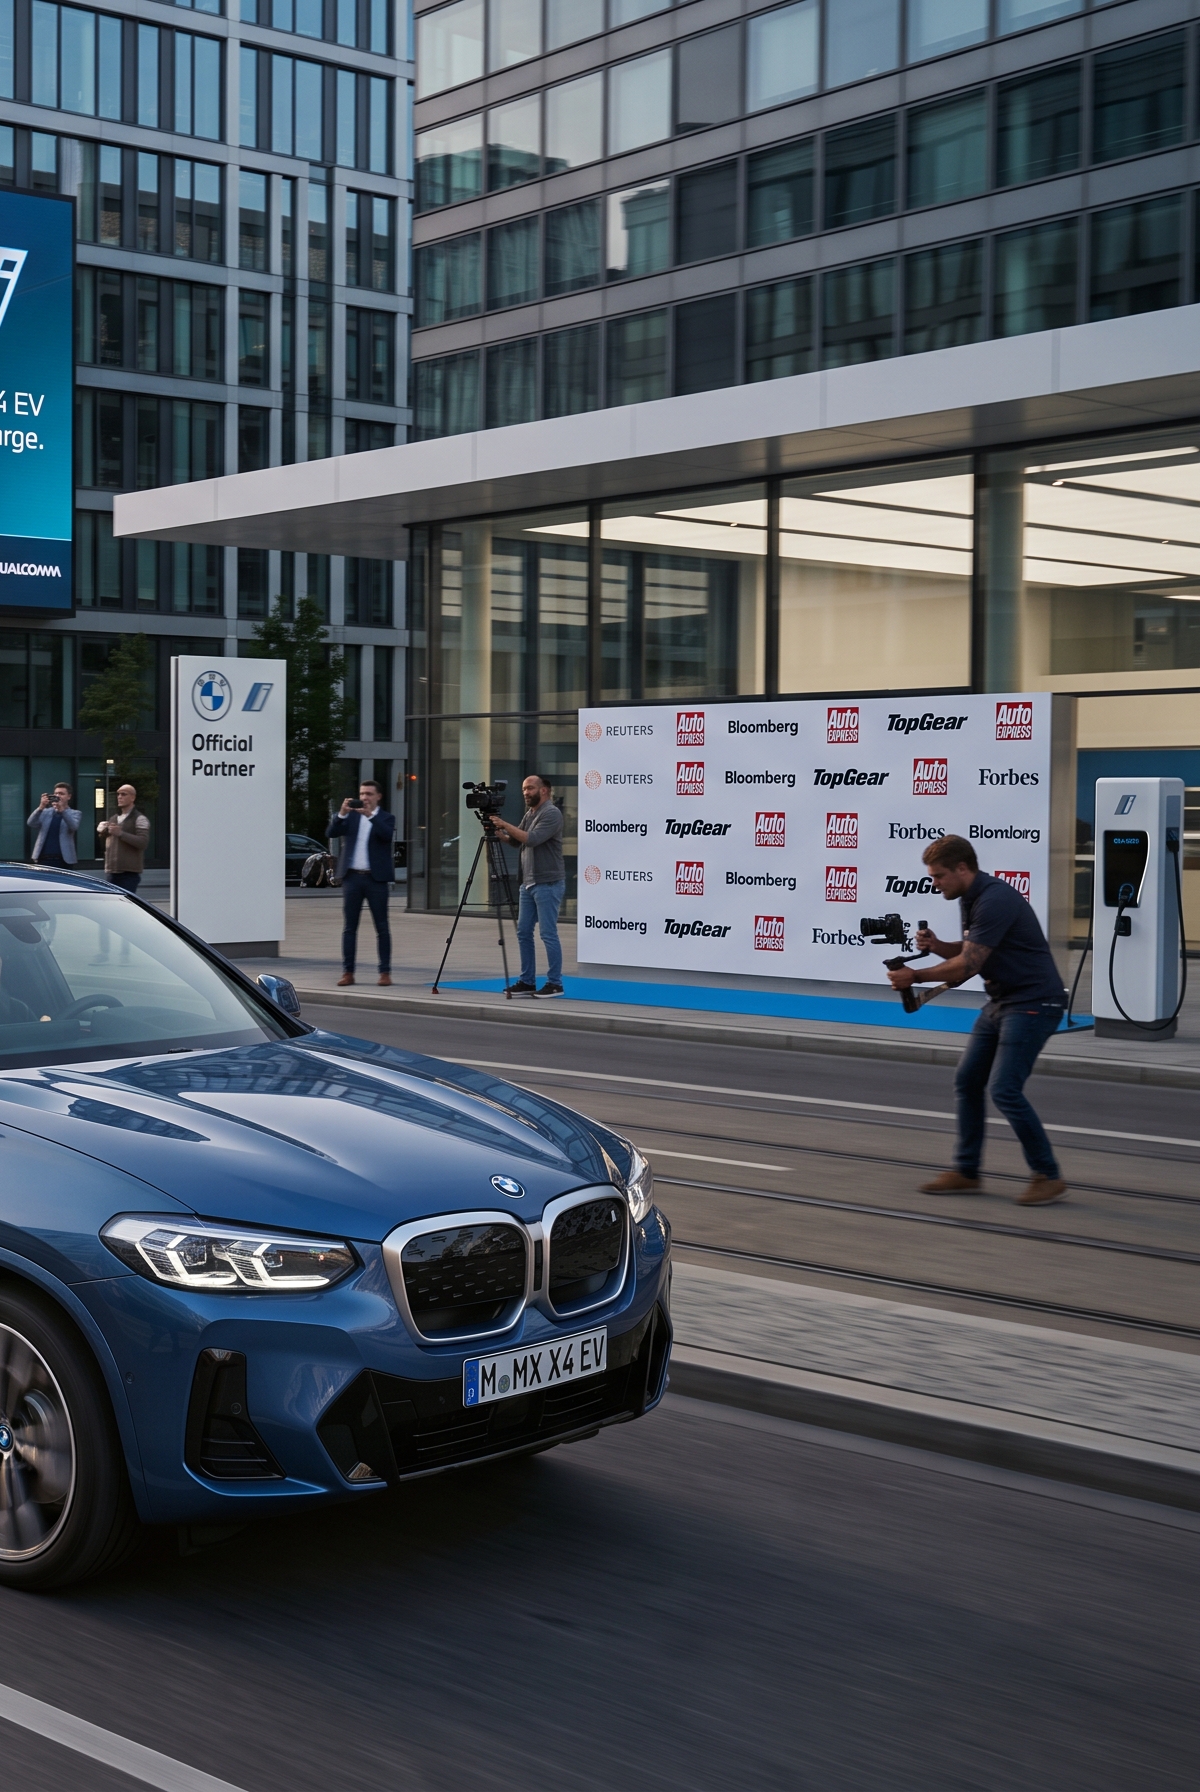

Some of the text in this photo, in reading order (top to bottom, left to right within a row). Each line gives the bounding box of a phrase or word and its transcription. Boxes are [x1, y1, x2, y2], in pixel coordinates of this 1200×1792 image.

[14, 391, 45, 416] EV
[677, 713, 704, 732] Auto
[827, 709, 859, 729] Auto
[887, 712, 969, 735] TopGear
[996, 704, 1032, 726] Auto
[606, 725, 654, 737] REUTERS
[728, 719, 799, 737] Bloomberg
[191, 733, 253, 752] Official
[192, 758, 256, 777] Partner
[677, 763, 704, 782] Auto
[913, 760, 947, 781] Auto
[978, 768, 1039, 786] Forbes
[605, 773, 654, 785] REUTERS
[725, 770, 796, 788] Bloomberg
[813, 768, 890, 789] TopGear
[585, 819, 648, 837] Bloomberg
[665, 818, 732, 839] TopGear
[755, 813, 785, 833] Auto
[826, 814, 858, 834] Auto
[888, 822, 946, 840] Forbes
[605, 869, 653, 882] REUTERS
[676, 862, 704, 882] Auto
[725, 871, 797, 891] Bloomberg
[826, 867, 857, 888] Auto
[885, 875, 942, 897] TopG
[584, 915, 647, 935] Bloomberg
[664, 918, 732, 939] TopGear
[754, 916, 784, 937] Auto
[811, 927, 865, 946] Forbes
[481, 1362, 497, 1398] M
[512, 1351, 543, 1391] MX
[547, 1343, 574, 1382] X4
[580, 1334, 605, 1373] EV
